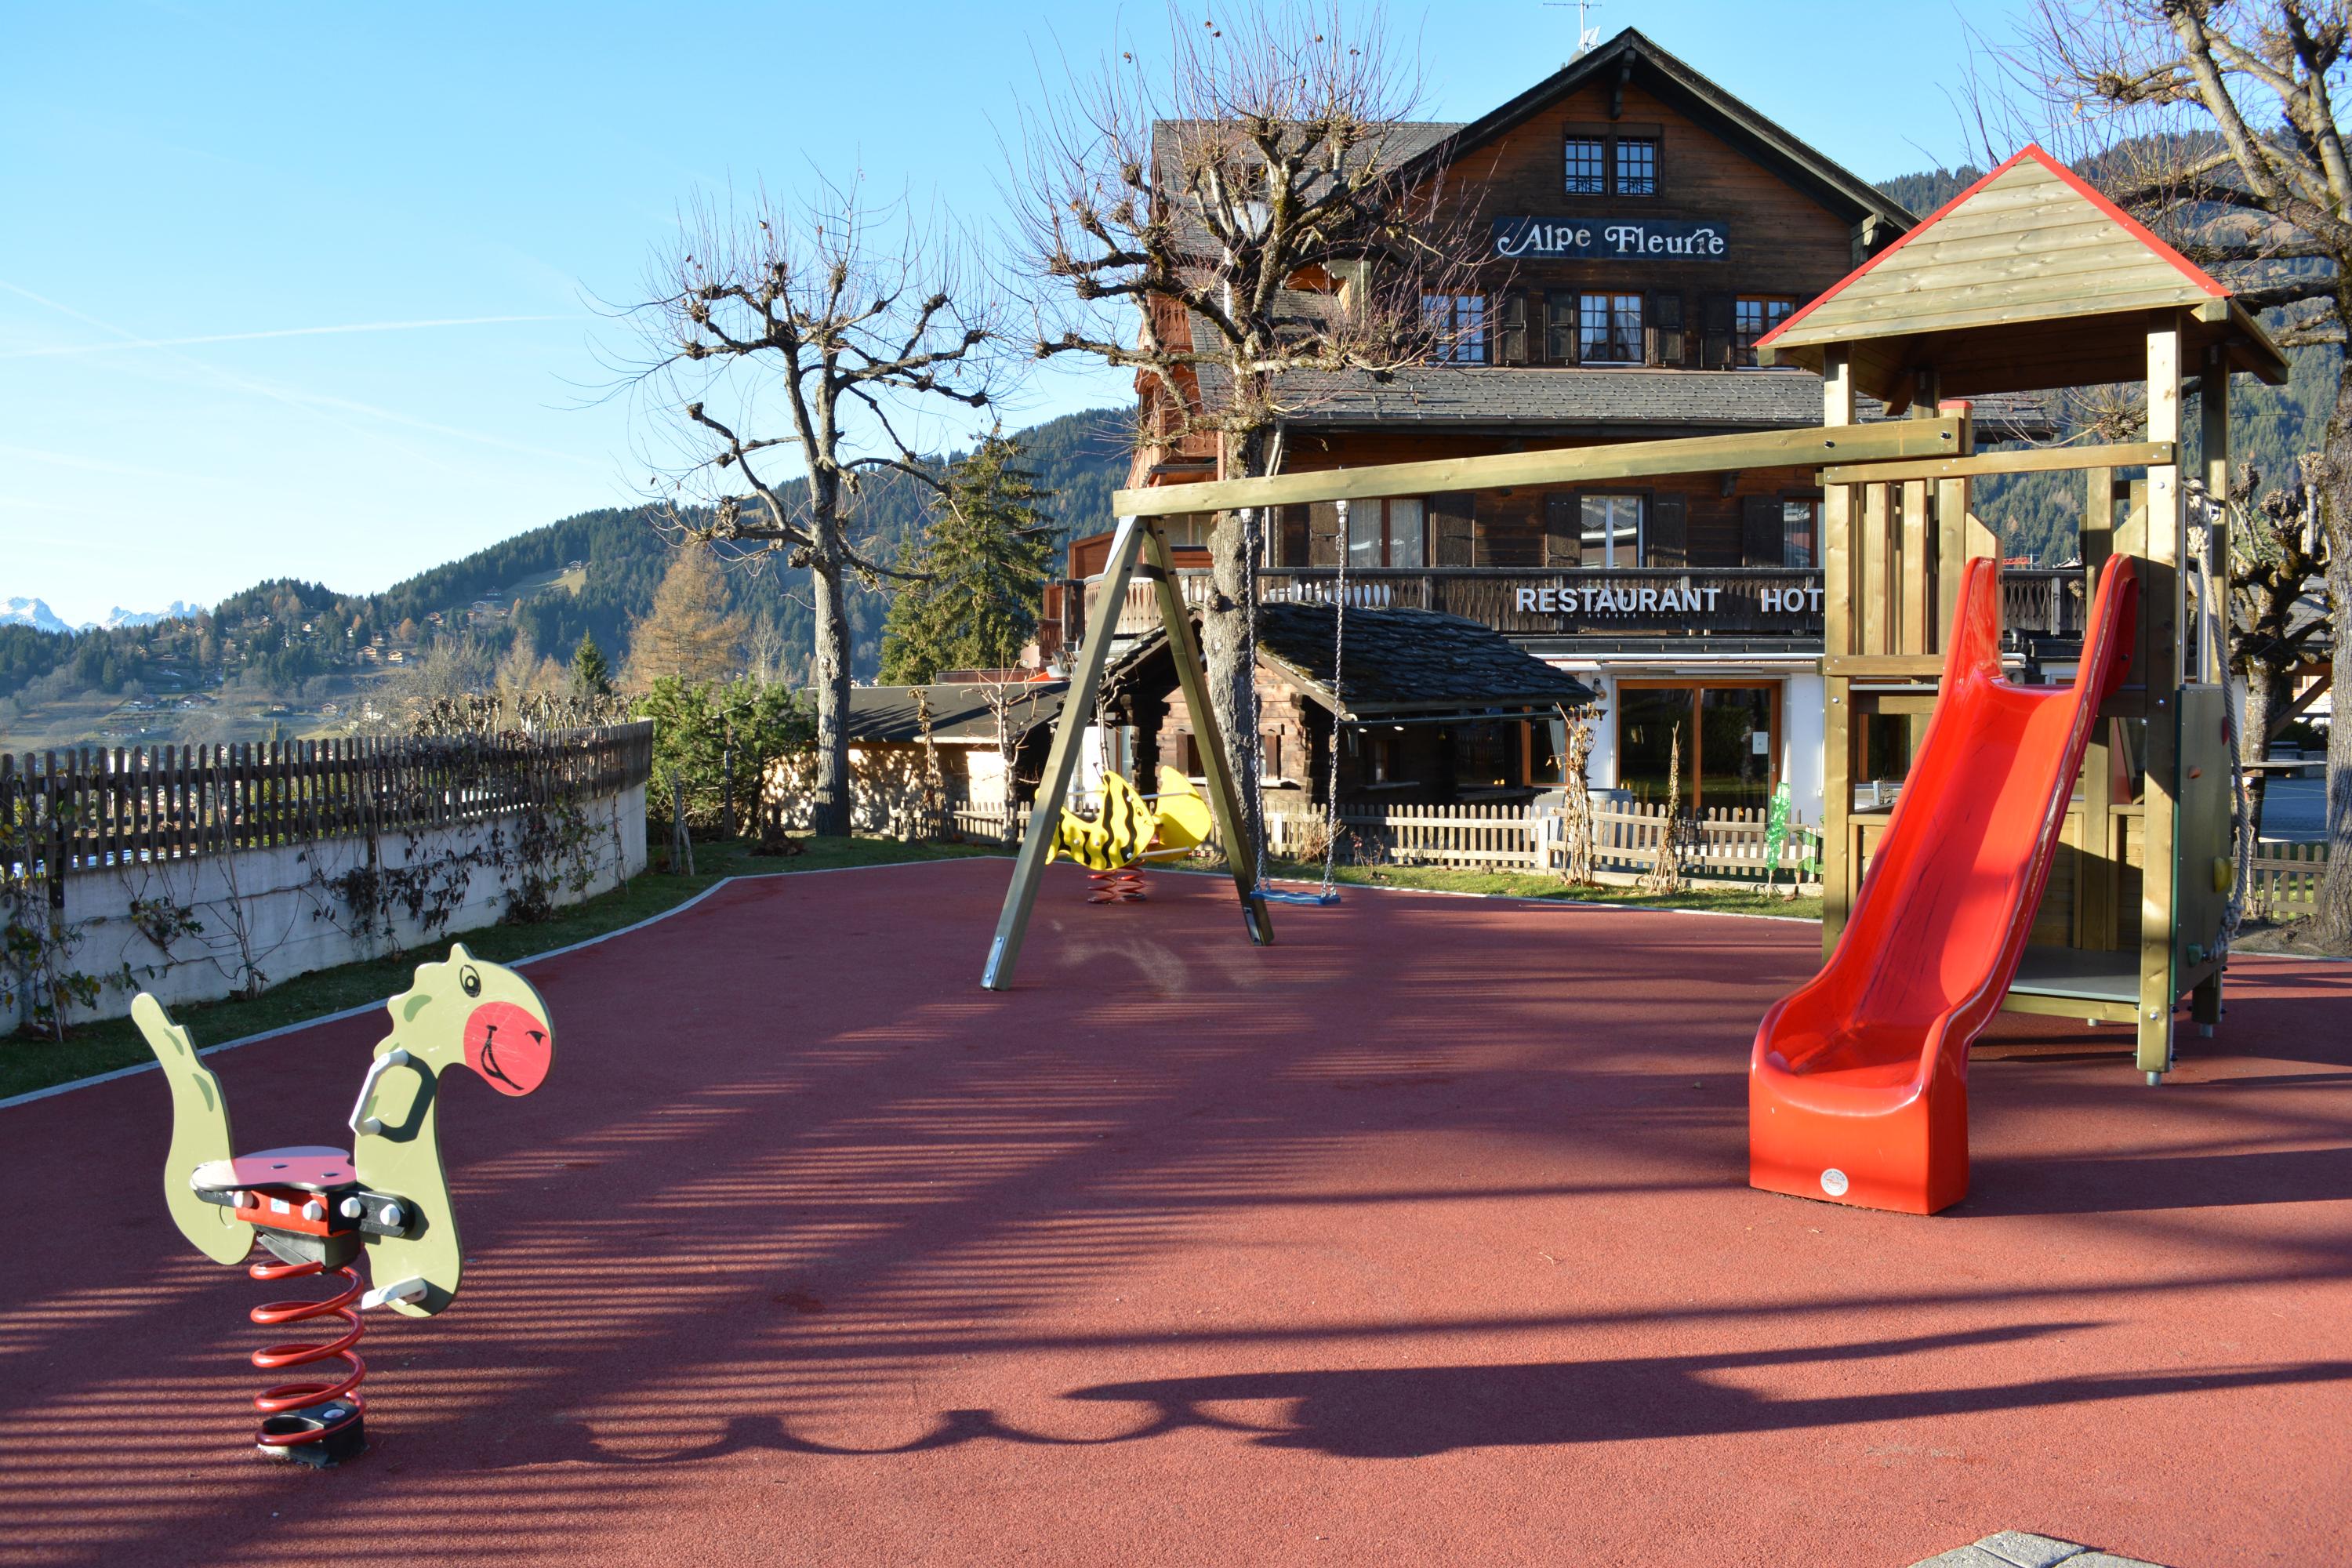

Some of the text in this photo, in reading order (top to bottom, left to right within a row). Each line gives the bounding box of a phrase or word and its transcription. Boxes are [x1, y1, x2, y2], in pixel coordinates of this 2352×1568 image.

[1497, 224, 1724, 256] Alpe Fleurie
[1516, 588, 1824, 612] RESTAURANT HOT
